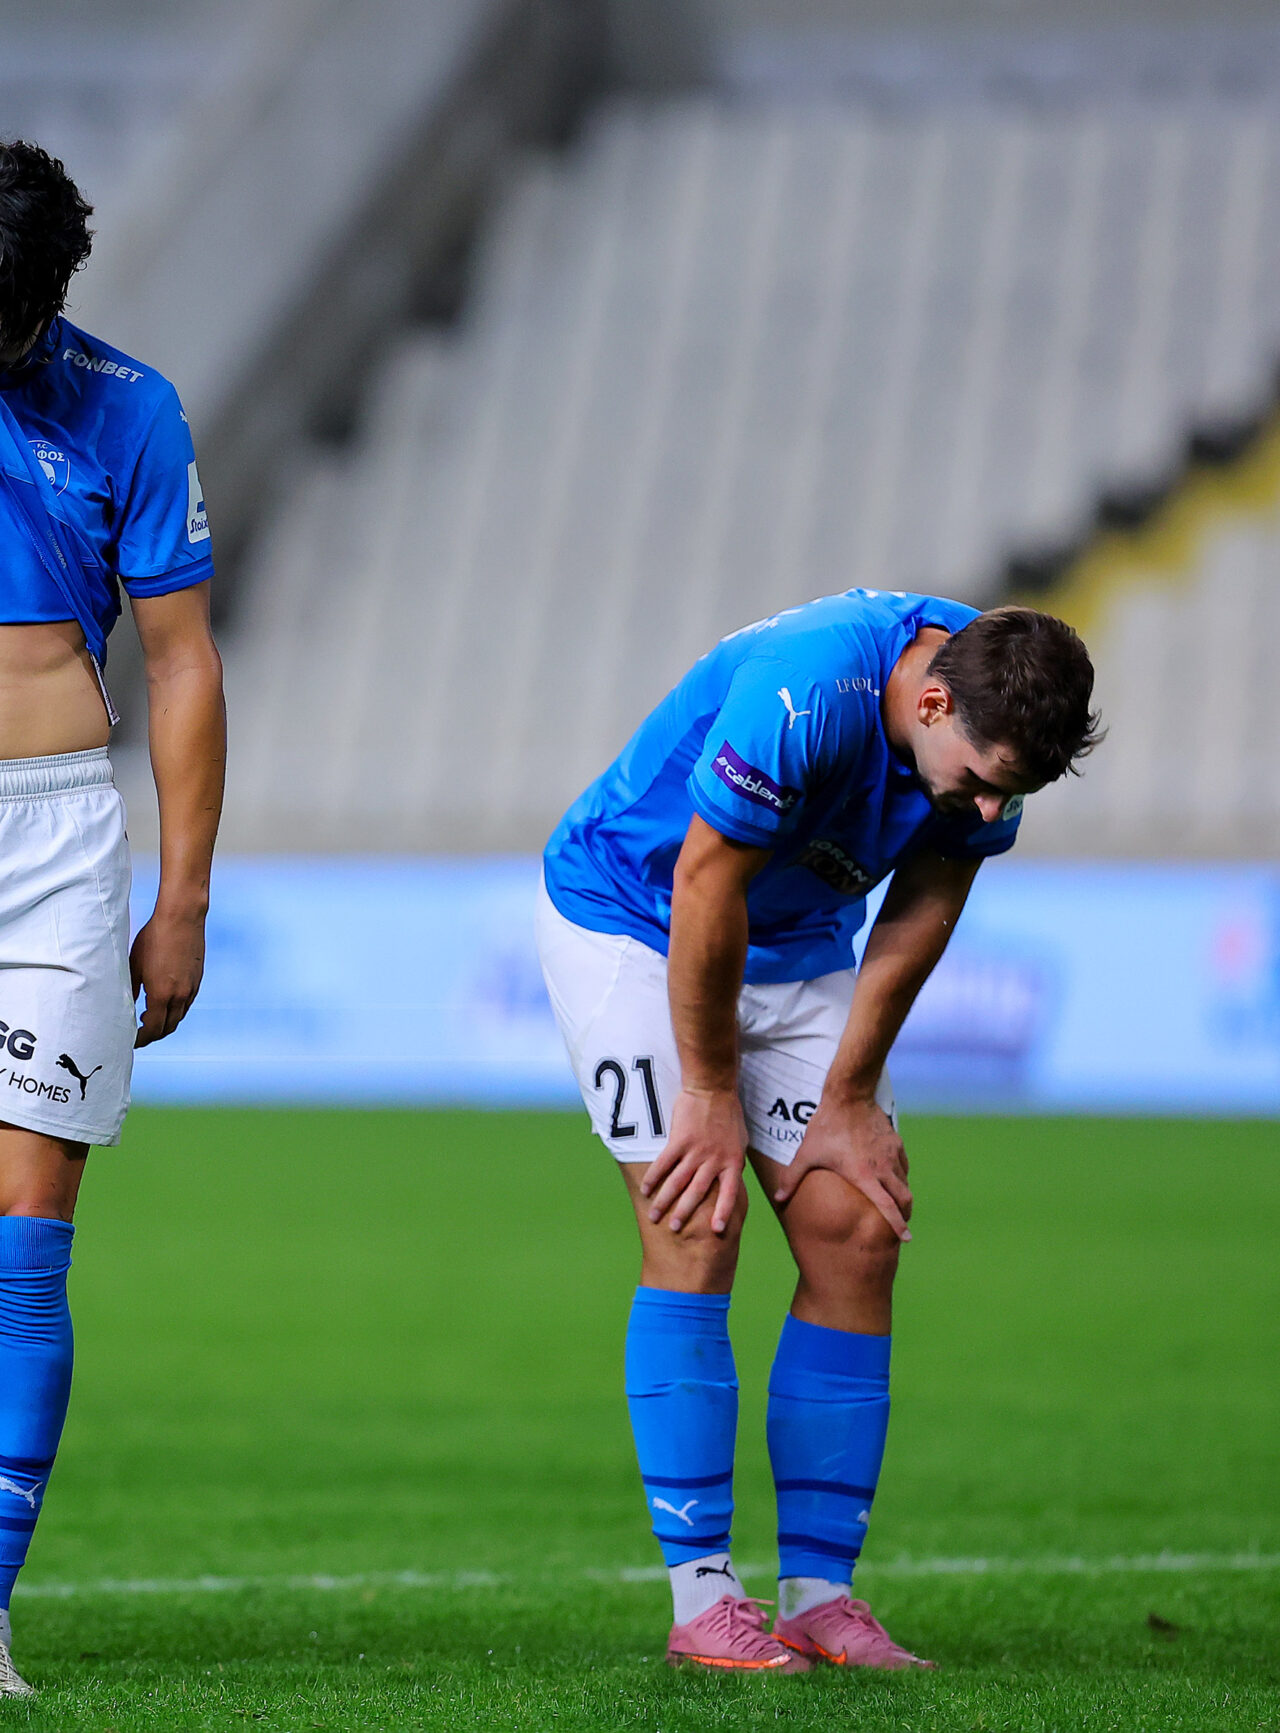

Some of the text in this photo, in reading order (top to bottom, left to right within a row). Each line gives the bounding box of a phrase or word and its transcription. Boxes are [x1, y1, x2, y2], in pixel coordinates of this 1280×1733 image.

[63, 348, 144, 383] FONBET
[8, 1071, 72, 1104] HOMES
[593, 1055, 667, 1141] 21
